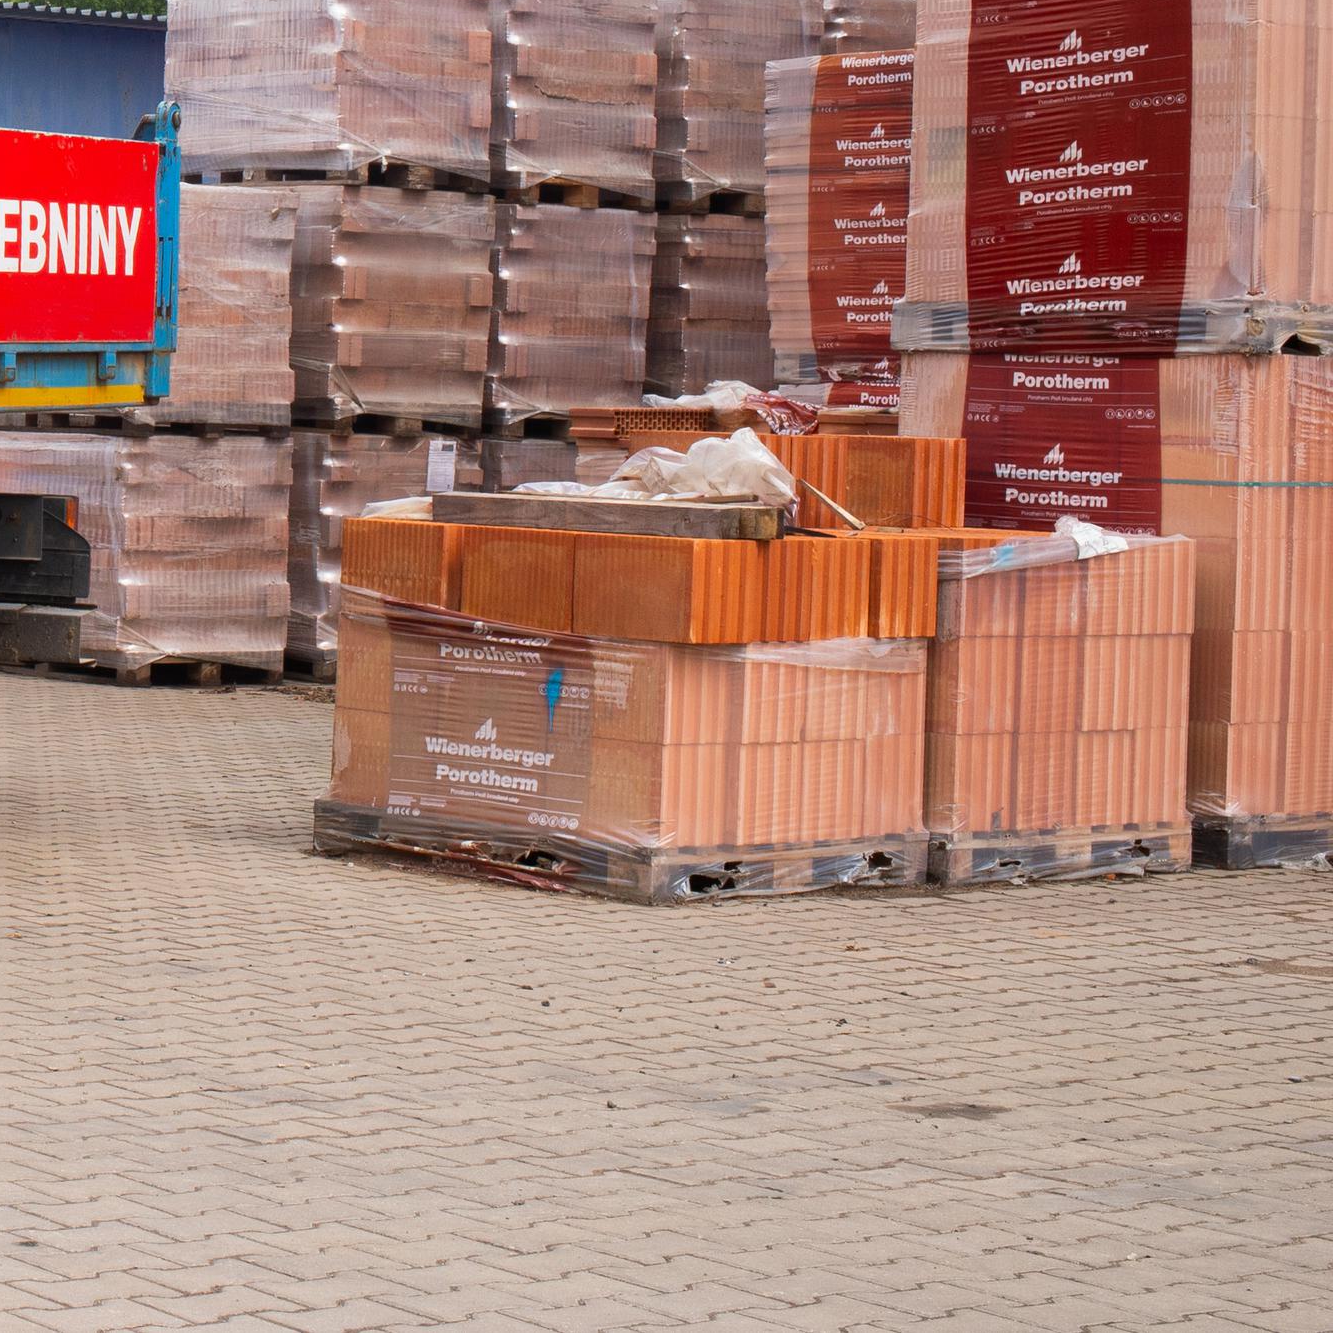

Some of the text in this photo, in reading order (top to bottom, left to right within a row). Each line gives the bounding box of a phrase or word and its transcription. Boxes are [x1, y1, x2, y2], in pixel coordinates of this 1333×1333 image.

[1006, 43, 1149, 74] Wienerberger
[847, 71, 912, 86] Porotherm
[1020, 69, 1134, 95] Porotherm
[1005, 158, 1149, 184] Wienerberger
[1019, 183, 1133, 206] Porotherm
[1006, 273, 1144, 295] Wienerberger
[1020, 298, 1127, 317] Porotherm
[1012, 371, 1110, 390] Porotherm
[994, 463, 1123, 487] Wienerberger
[1004, 487, 1108, 509] Porotherm
[439, 642, 543, 665] Porotherm
[425, 736, 555, 767] Wienerberger
[436, 764, 538, 792] Porotherm
